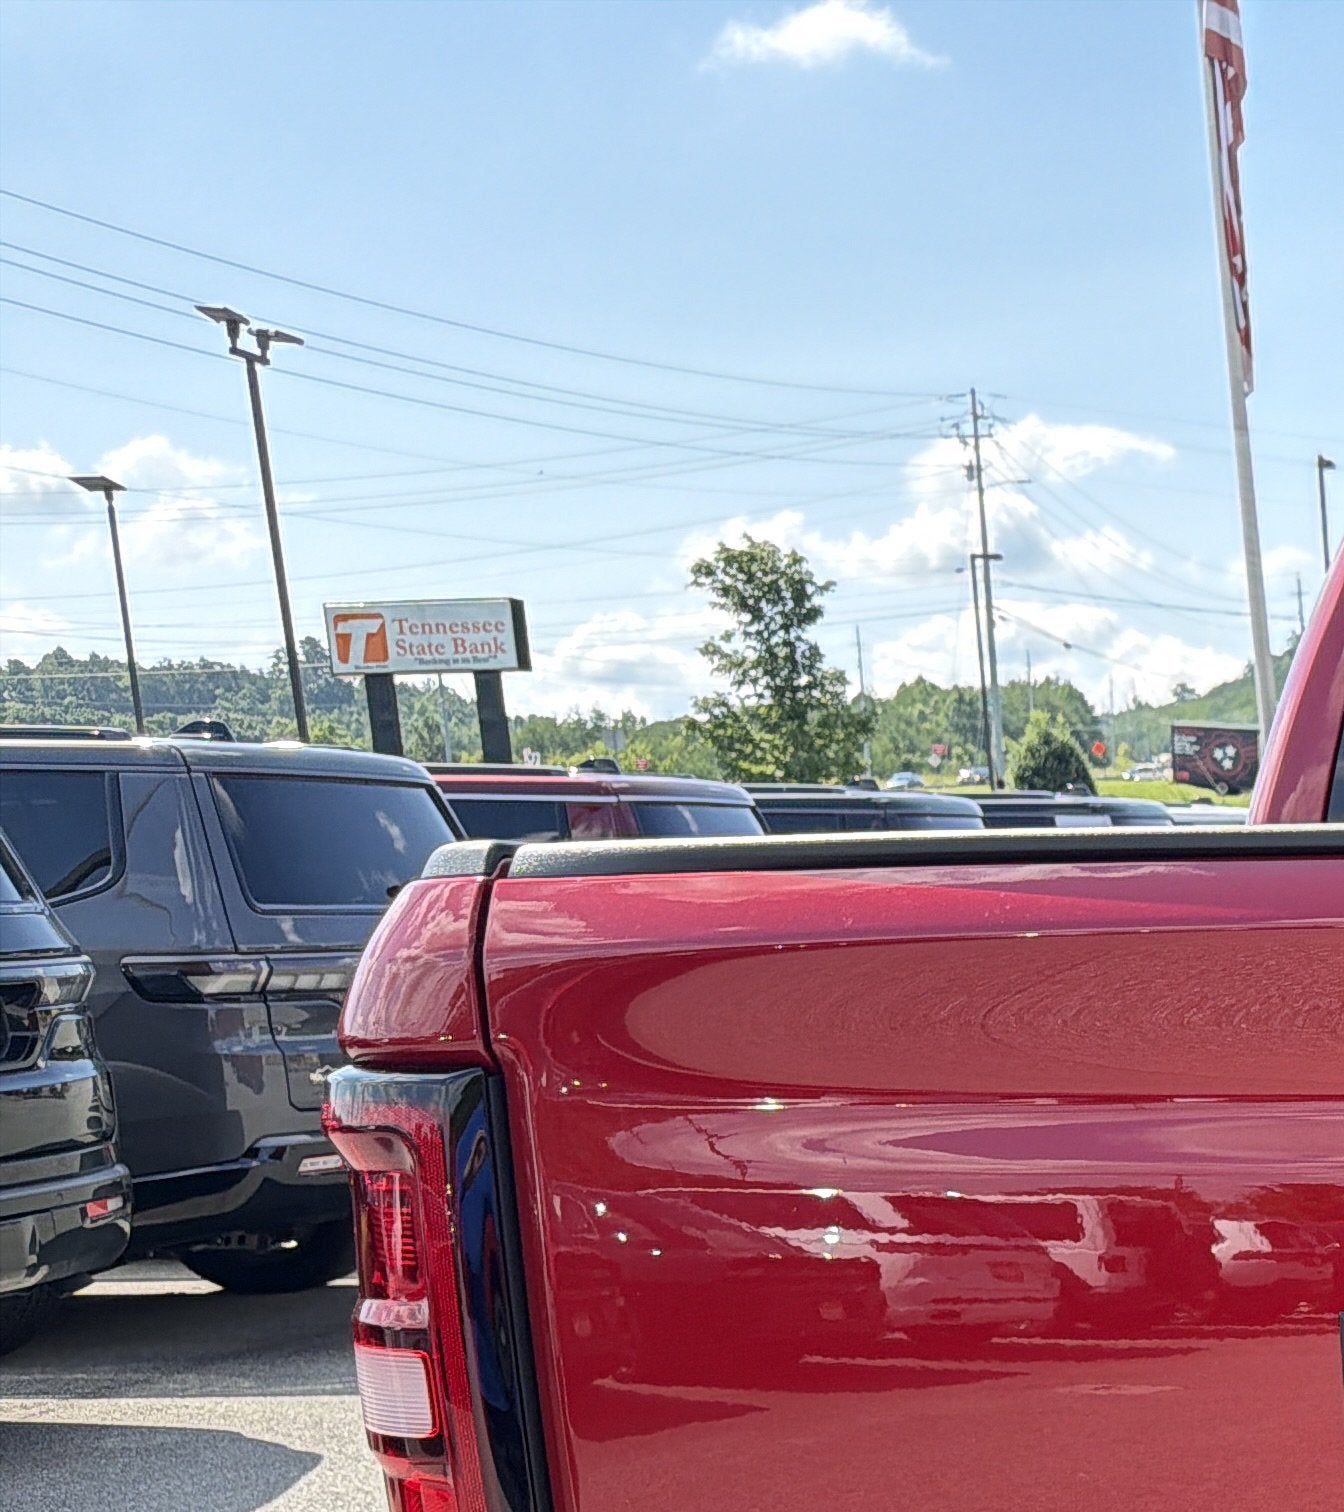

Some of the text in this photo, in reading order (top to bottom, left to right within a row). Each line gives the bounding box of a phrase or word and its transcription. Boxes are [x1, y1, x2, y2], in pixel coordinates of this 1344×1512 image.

[392, 617, 506, 636] Tennessee
[395, 636, 507, 657] State Bank
